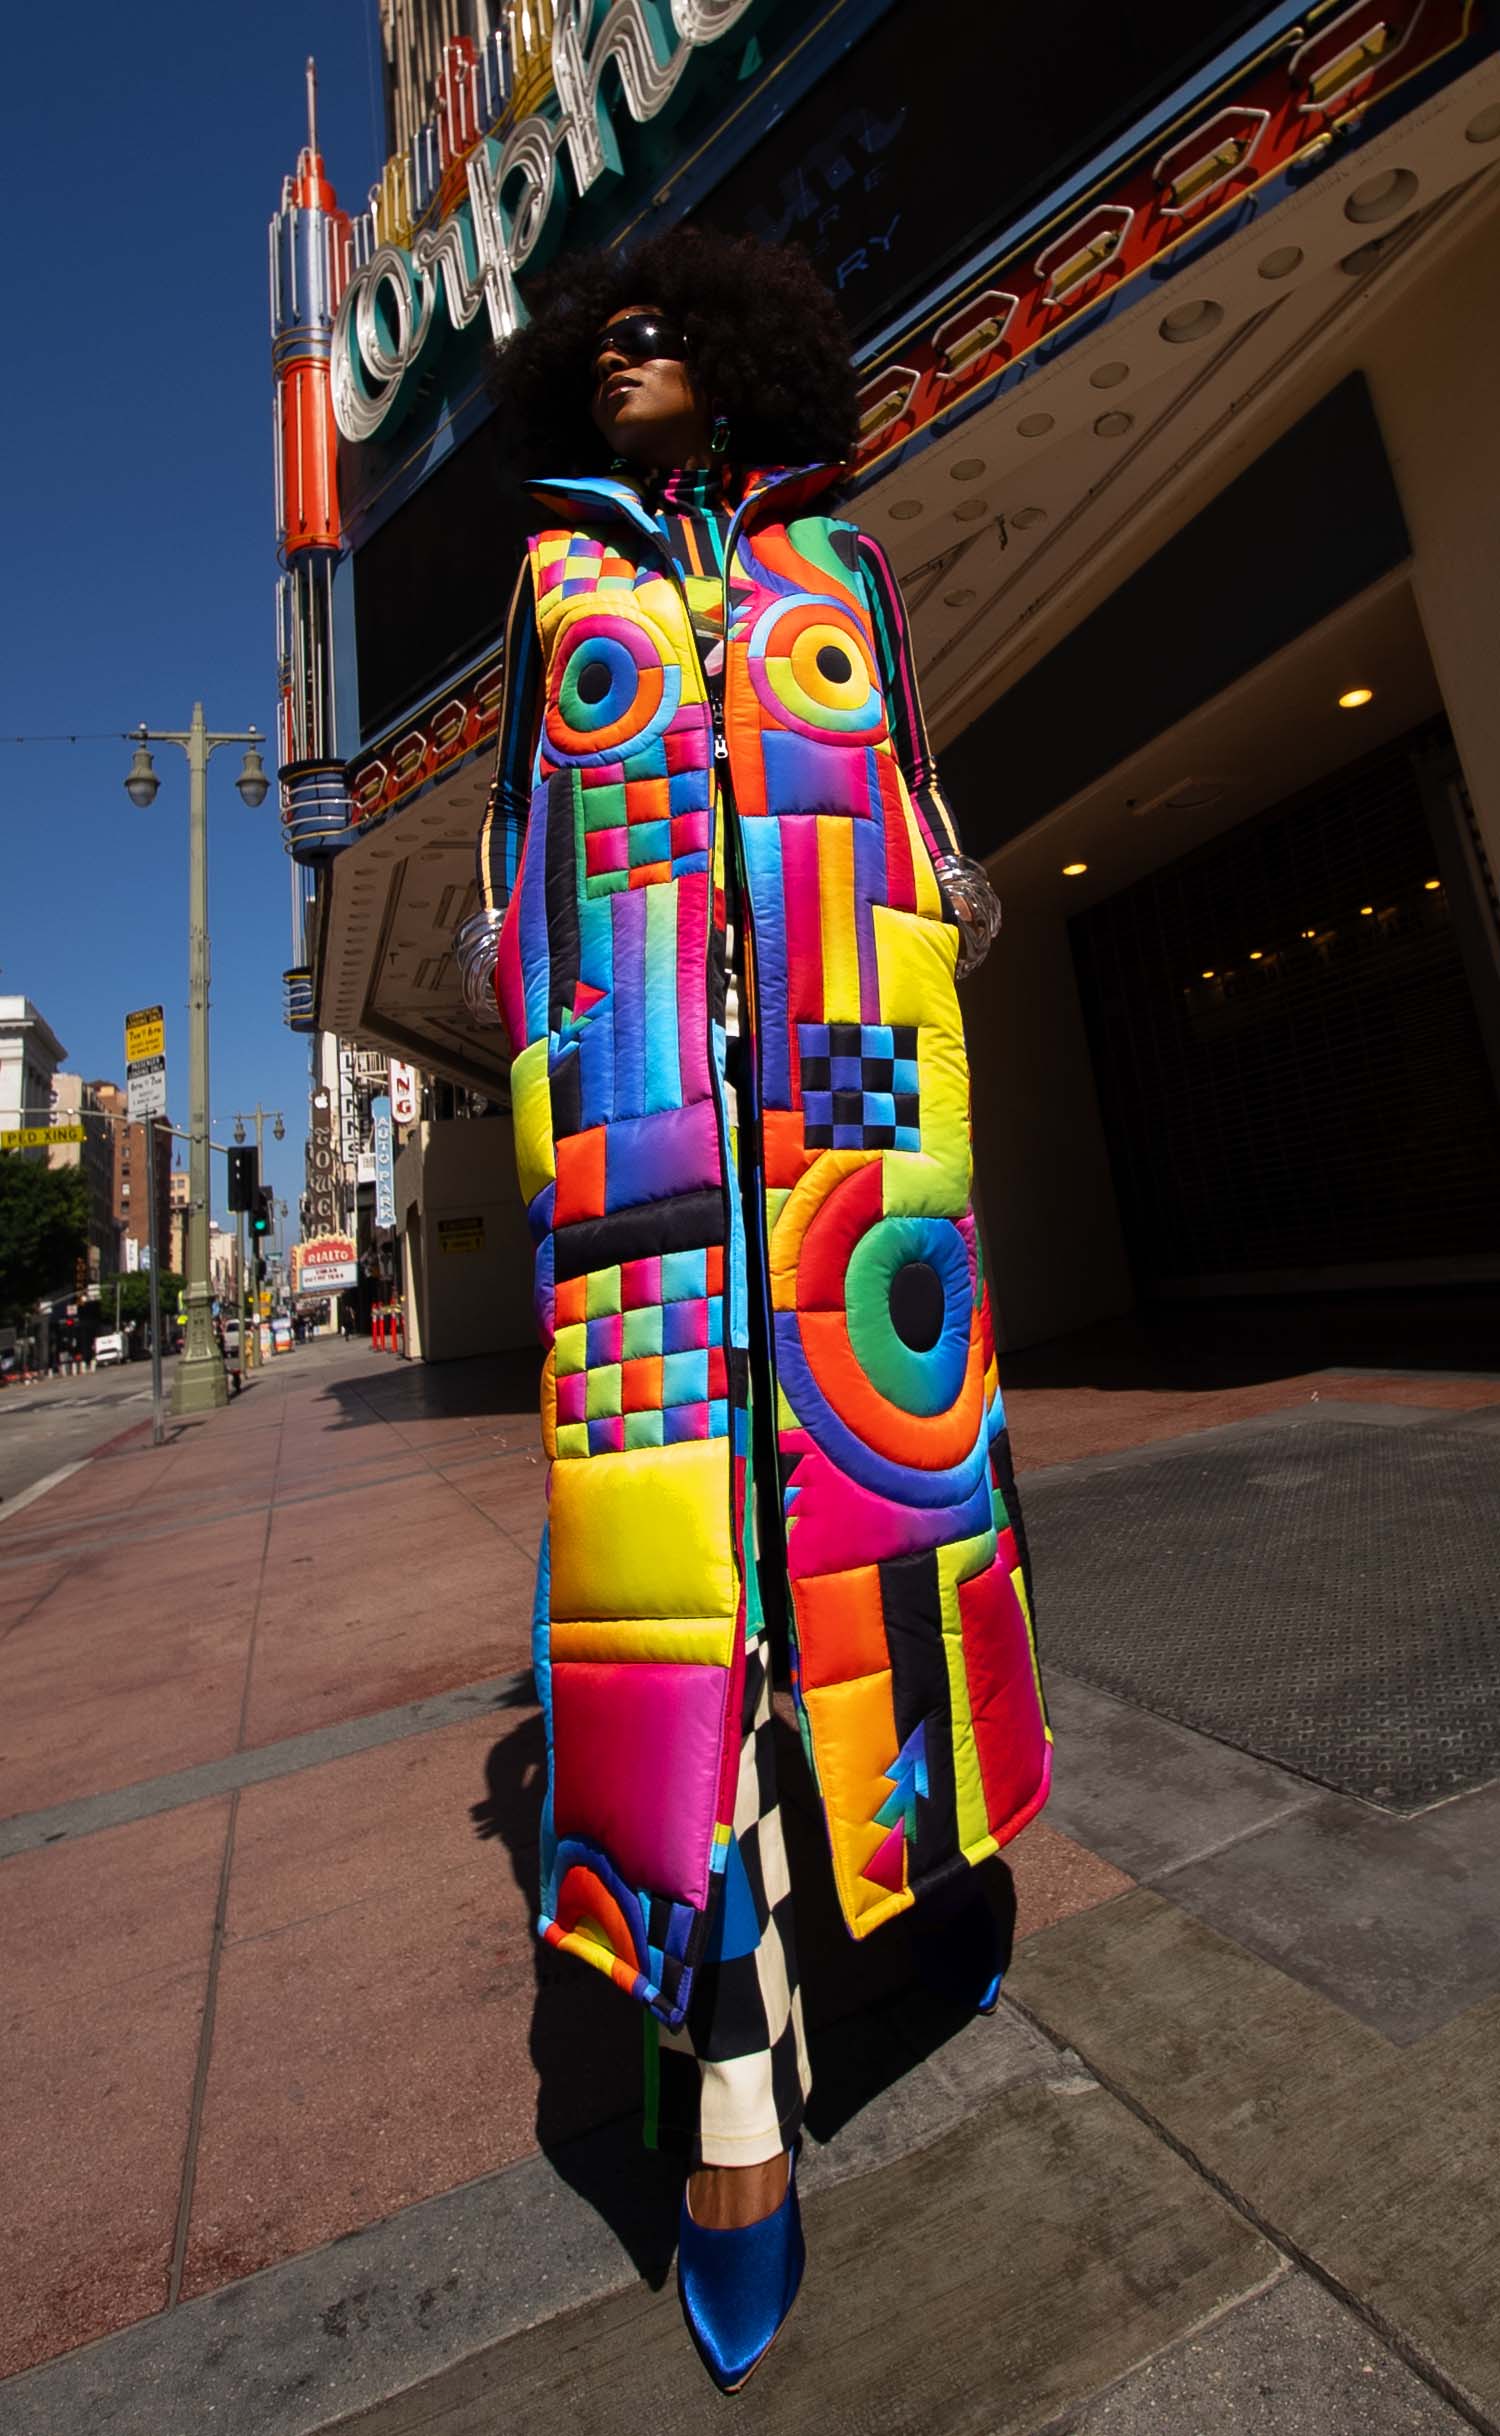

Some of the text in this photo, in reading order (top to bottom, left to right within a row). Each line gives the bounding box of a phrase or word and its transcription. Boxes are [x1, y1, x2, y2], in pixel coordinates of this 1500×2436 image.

[44, 1128, 77, 1143] XING
[378, 1116, 390, 1164] AUTO
[308, 1250, 349, 1264] RIALTO
